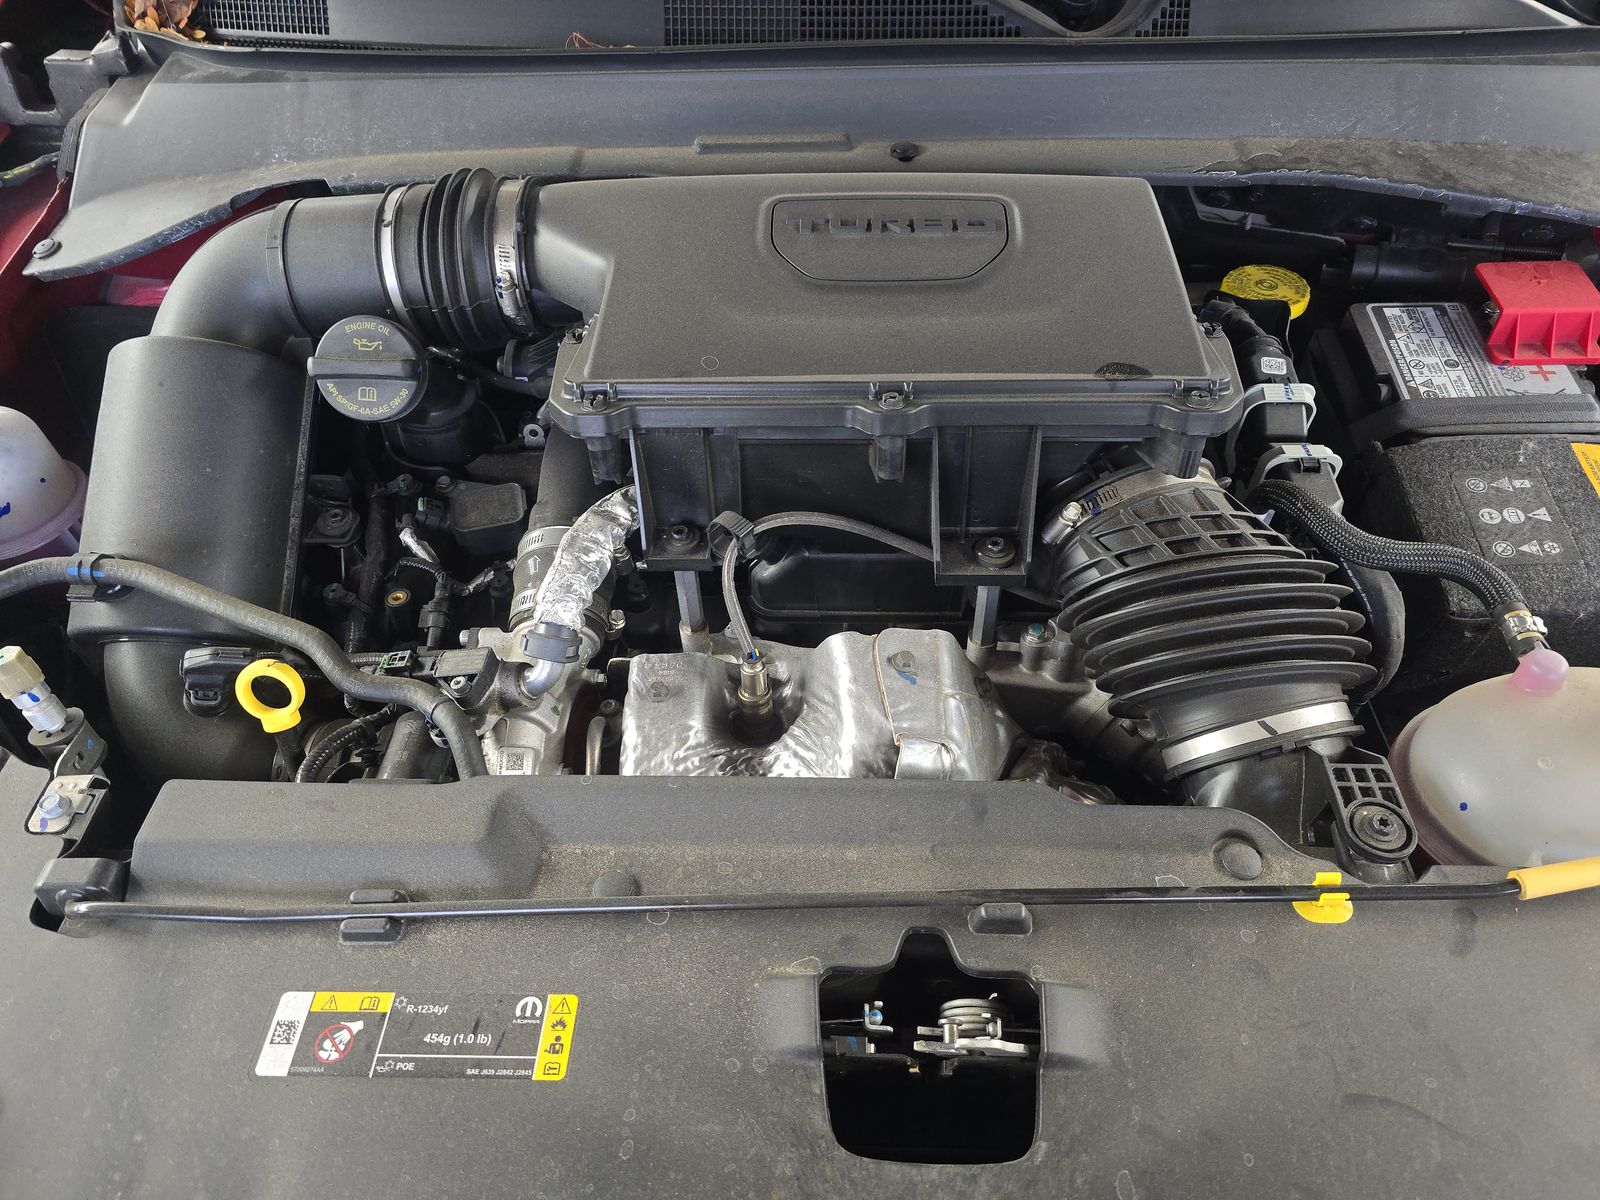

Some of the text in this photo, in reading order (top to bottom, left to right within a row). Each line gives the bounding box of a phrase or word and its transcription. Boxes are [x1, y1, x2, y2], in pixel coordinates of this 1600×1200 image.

[785, 215, 998, 235] TURBO
[344, 321, 392, 337] ENGINE OIL
[326, 382, 339, 398] API
[390, 387, 409, 409] 5W-30
[406, 1004, 449, 1016] R-1234yf
[423, 1032, 492, 1047] 454g (1.0 lb)
[395, 1062, 416, 1071] POE
[466, 1067, 480, 1076] SAE
[495, 1068, 514, 1076] J2842
